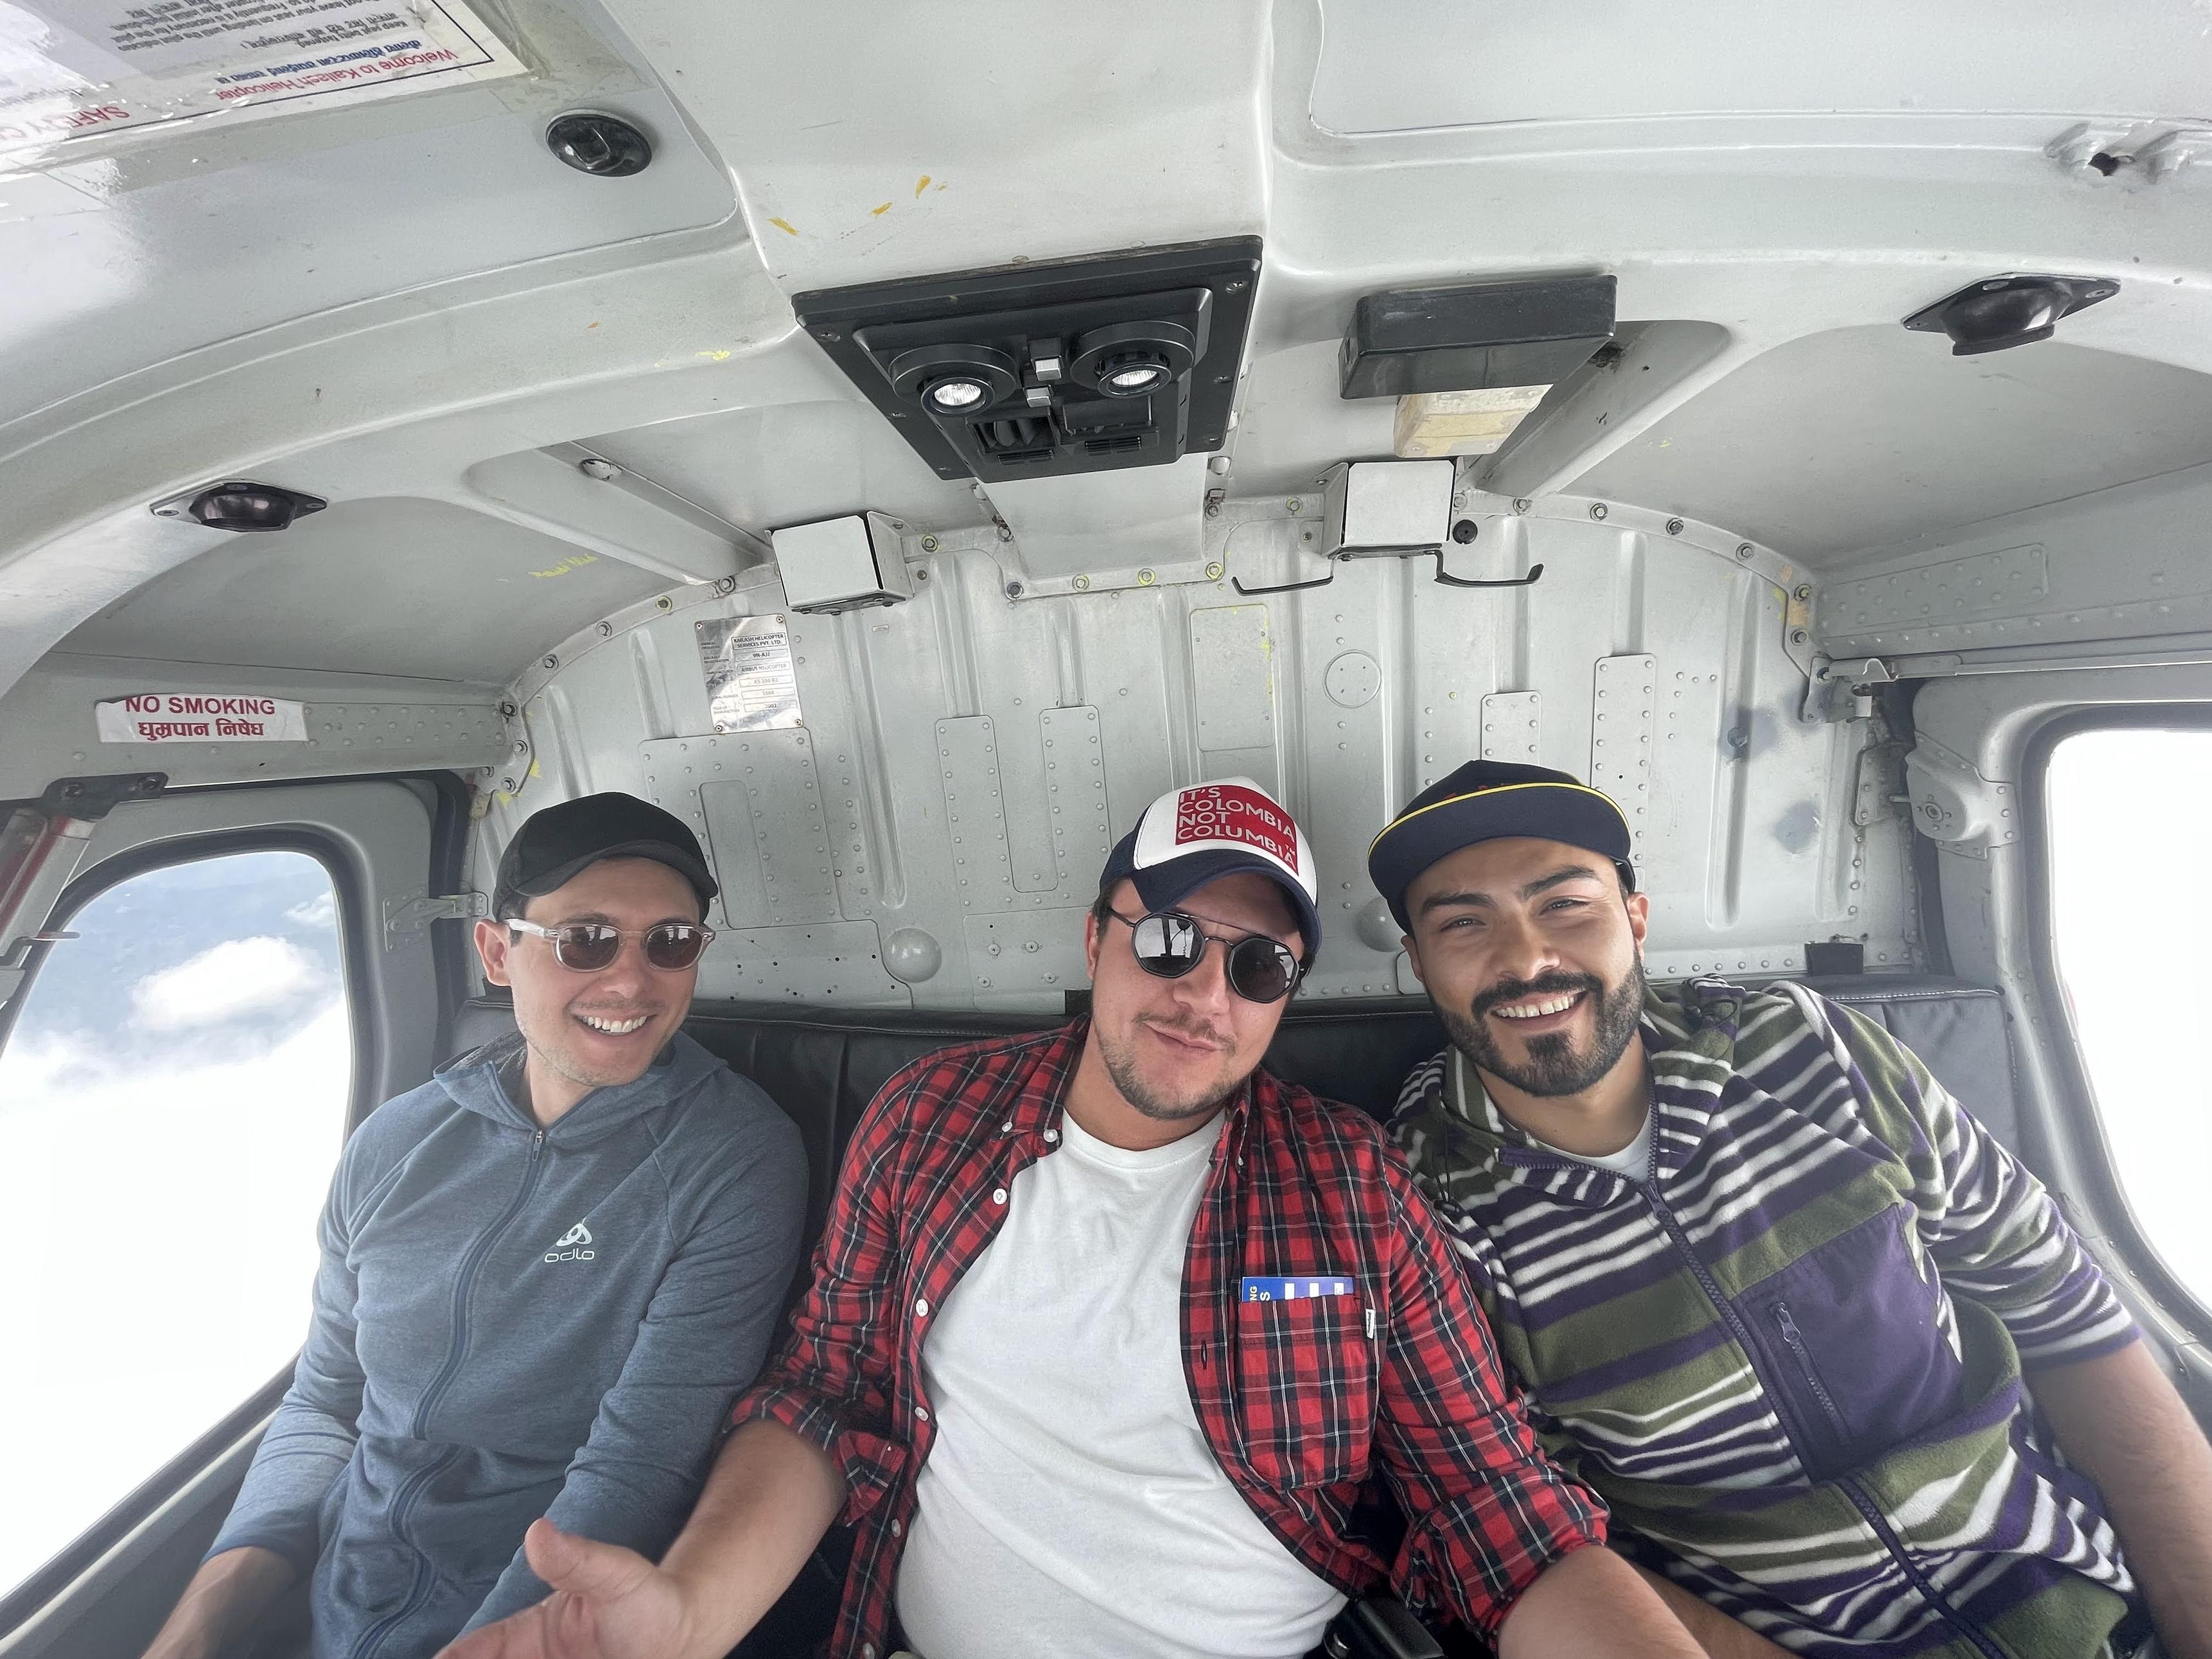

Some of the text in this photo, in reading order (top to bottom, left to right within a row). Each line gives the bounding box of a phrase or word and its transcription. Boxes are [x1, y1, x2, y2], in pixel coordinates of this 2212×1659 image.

[319, 1, 347, 10] leave
[382, 20, 408, 30] Keep
[216, 48, 459, 100] Welcome to Kailash Helicopter
[125, 696, 276, 715] NO SMOKING
[1180, 787, 1221, 803] IT'S
[1179, 811, 1231, 828] NOT
[1179, 798, 1295, 843] COLOMBIA
[1177, 825, 1297, 870] COLUMBIA
[544, 1248, 595, 1263] odlo
